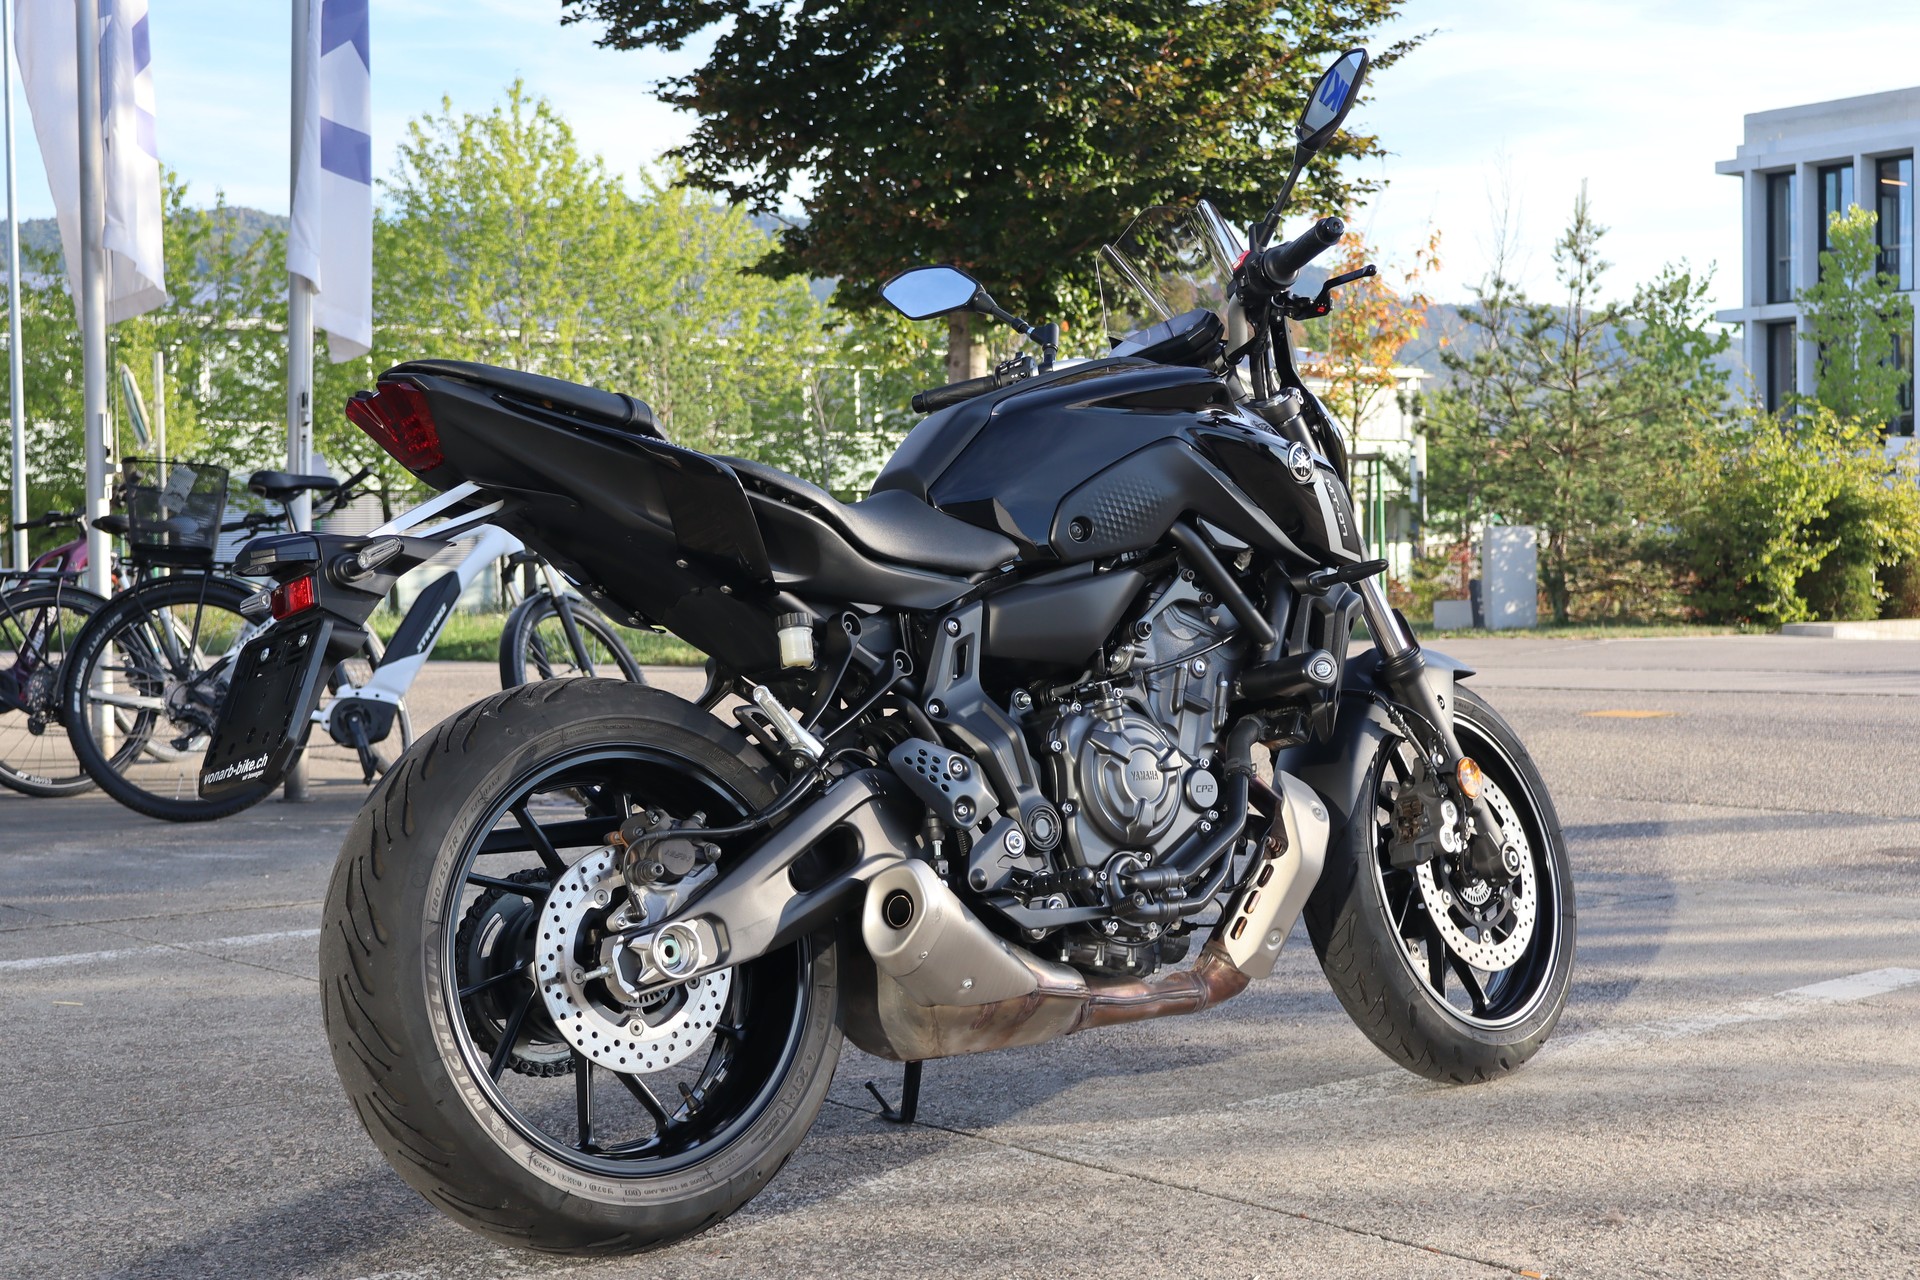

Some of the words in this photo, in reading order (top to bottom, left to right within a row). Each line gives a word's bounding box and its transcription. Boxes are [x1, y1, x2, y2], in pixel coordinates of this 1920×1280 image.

[1325, 478, 1348, 537] MT-07
[417, 602, 447, 654] STEVENS
[203, 752, 269, 785] vonarb-bike.ch
[1130, 770, 1159, 781] YAMAHA
[1195, 784, 1213, 793] CP2
[431, 859, 449, 913] 180/55
[448, 836, 459, 857] ZR
[459, 817, 468, 834] 17
[425, 945, 488, 1112] MICHELIN
[816, 988, 829, 1030] ROAD
